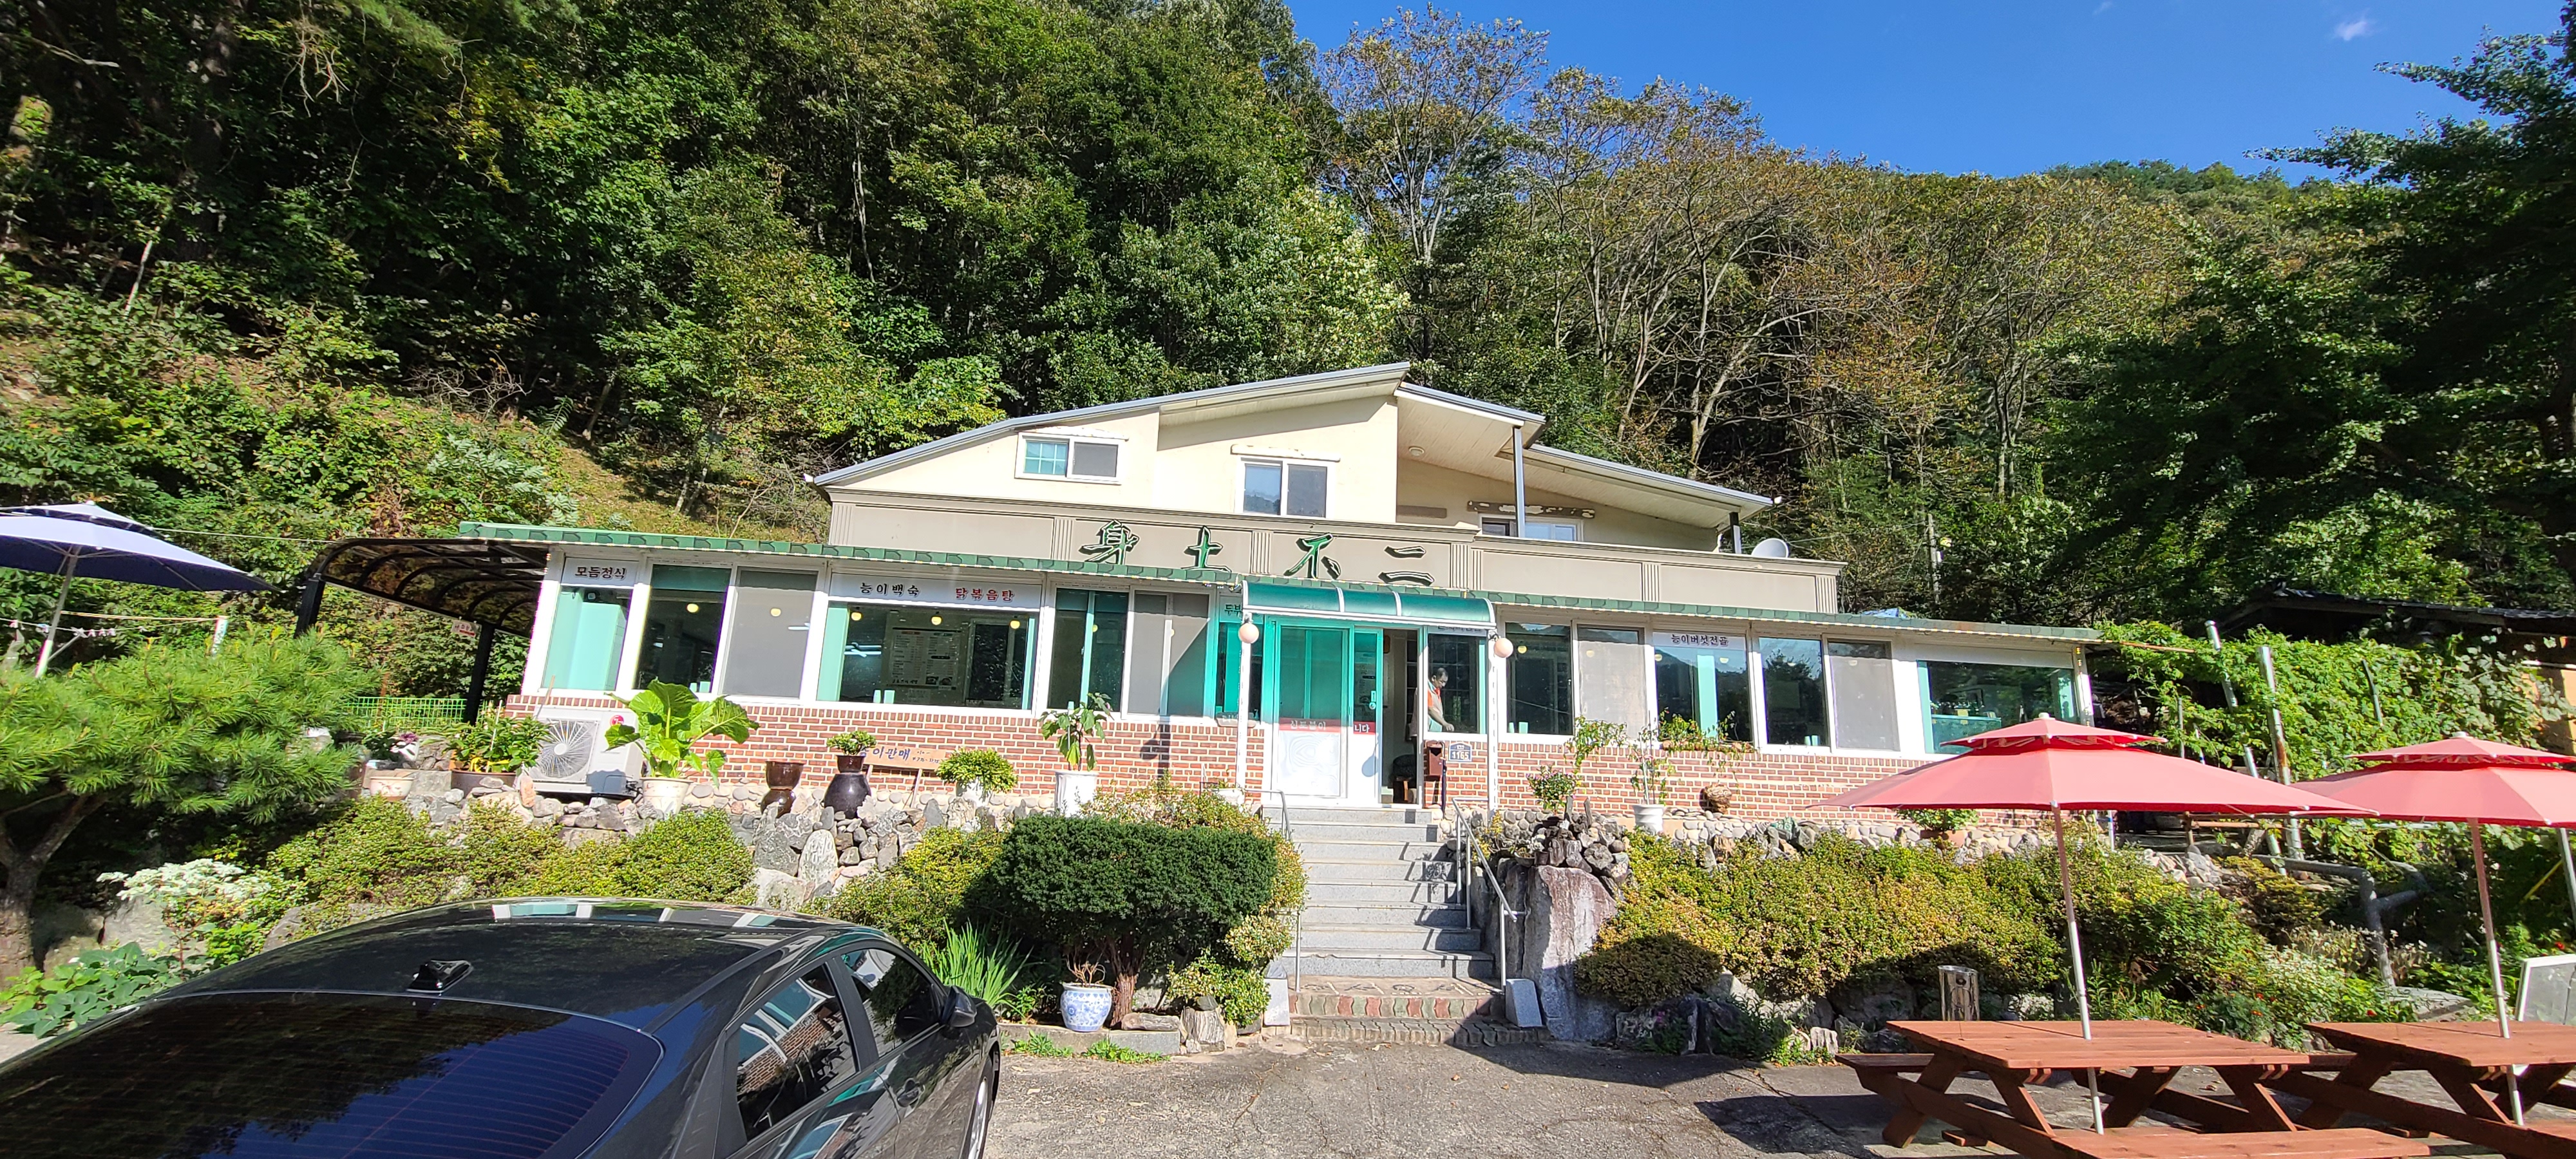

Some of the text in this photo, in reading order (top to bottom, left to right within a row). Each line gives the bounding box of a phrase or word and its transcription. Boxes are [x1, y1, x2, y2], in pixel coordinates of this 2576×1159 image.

[1079, 520, 1434, 586] 身土不二
[575, 567, 626, 579] 모듬정식
[860, 582, 1014, 601] 능이백숙 닭볶음탕
[1671, 634, 1728, 645] 능이버섯전골
[1291, 720, 1326, 730] 신토불이
[1452, 751, 1469, 760] 1165
